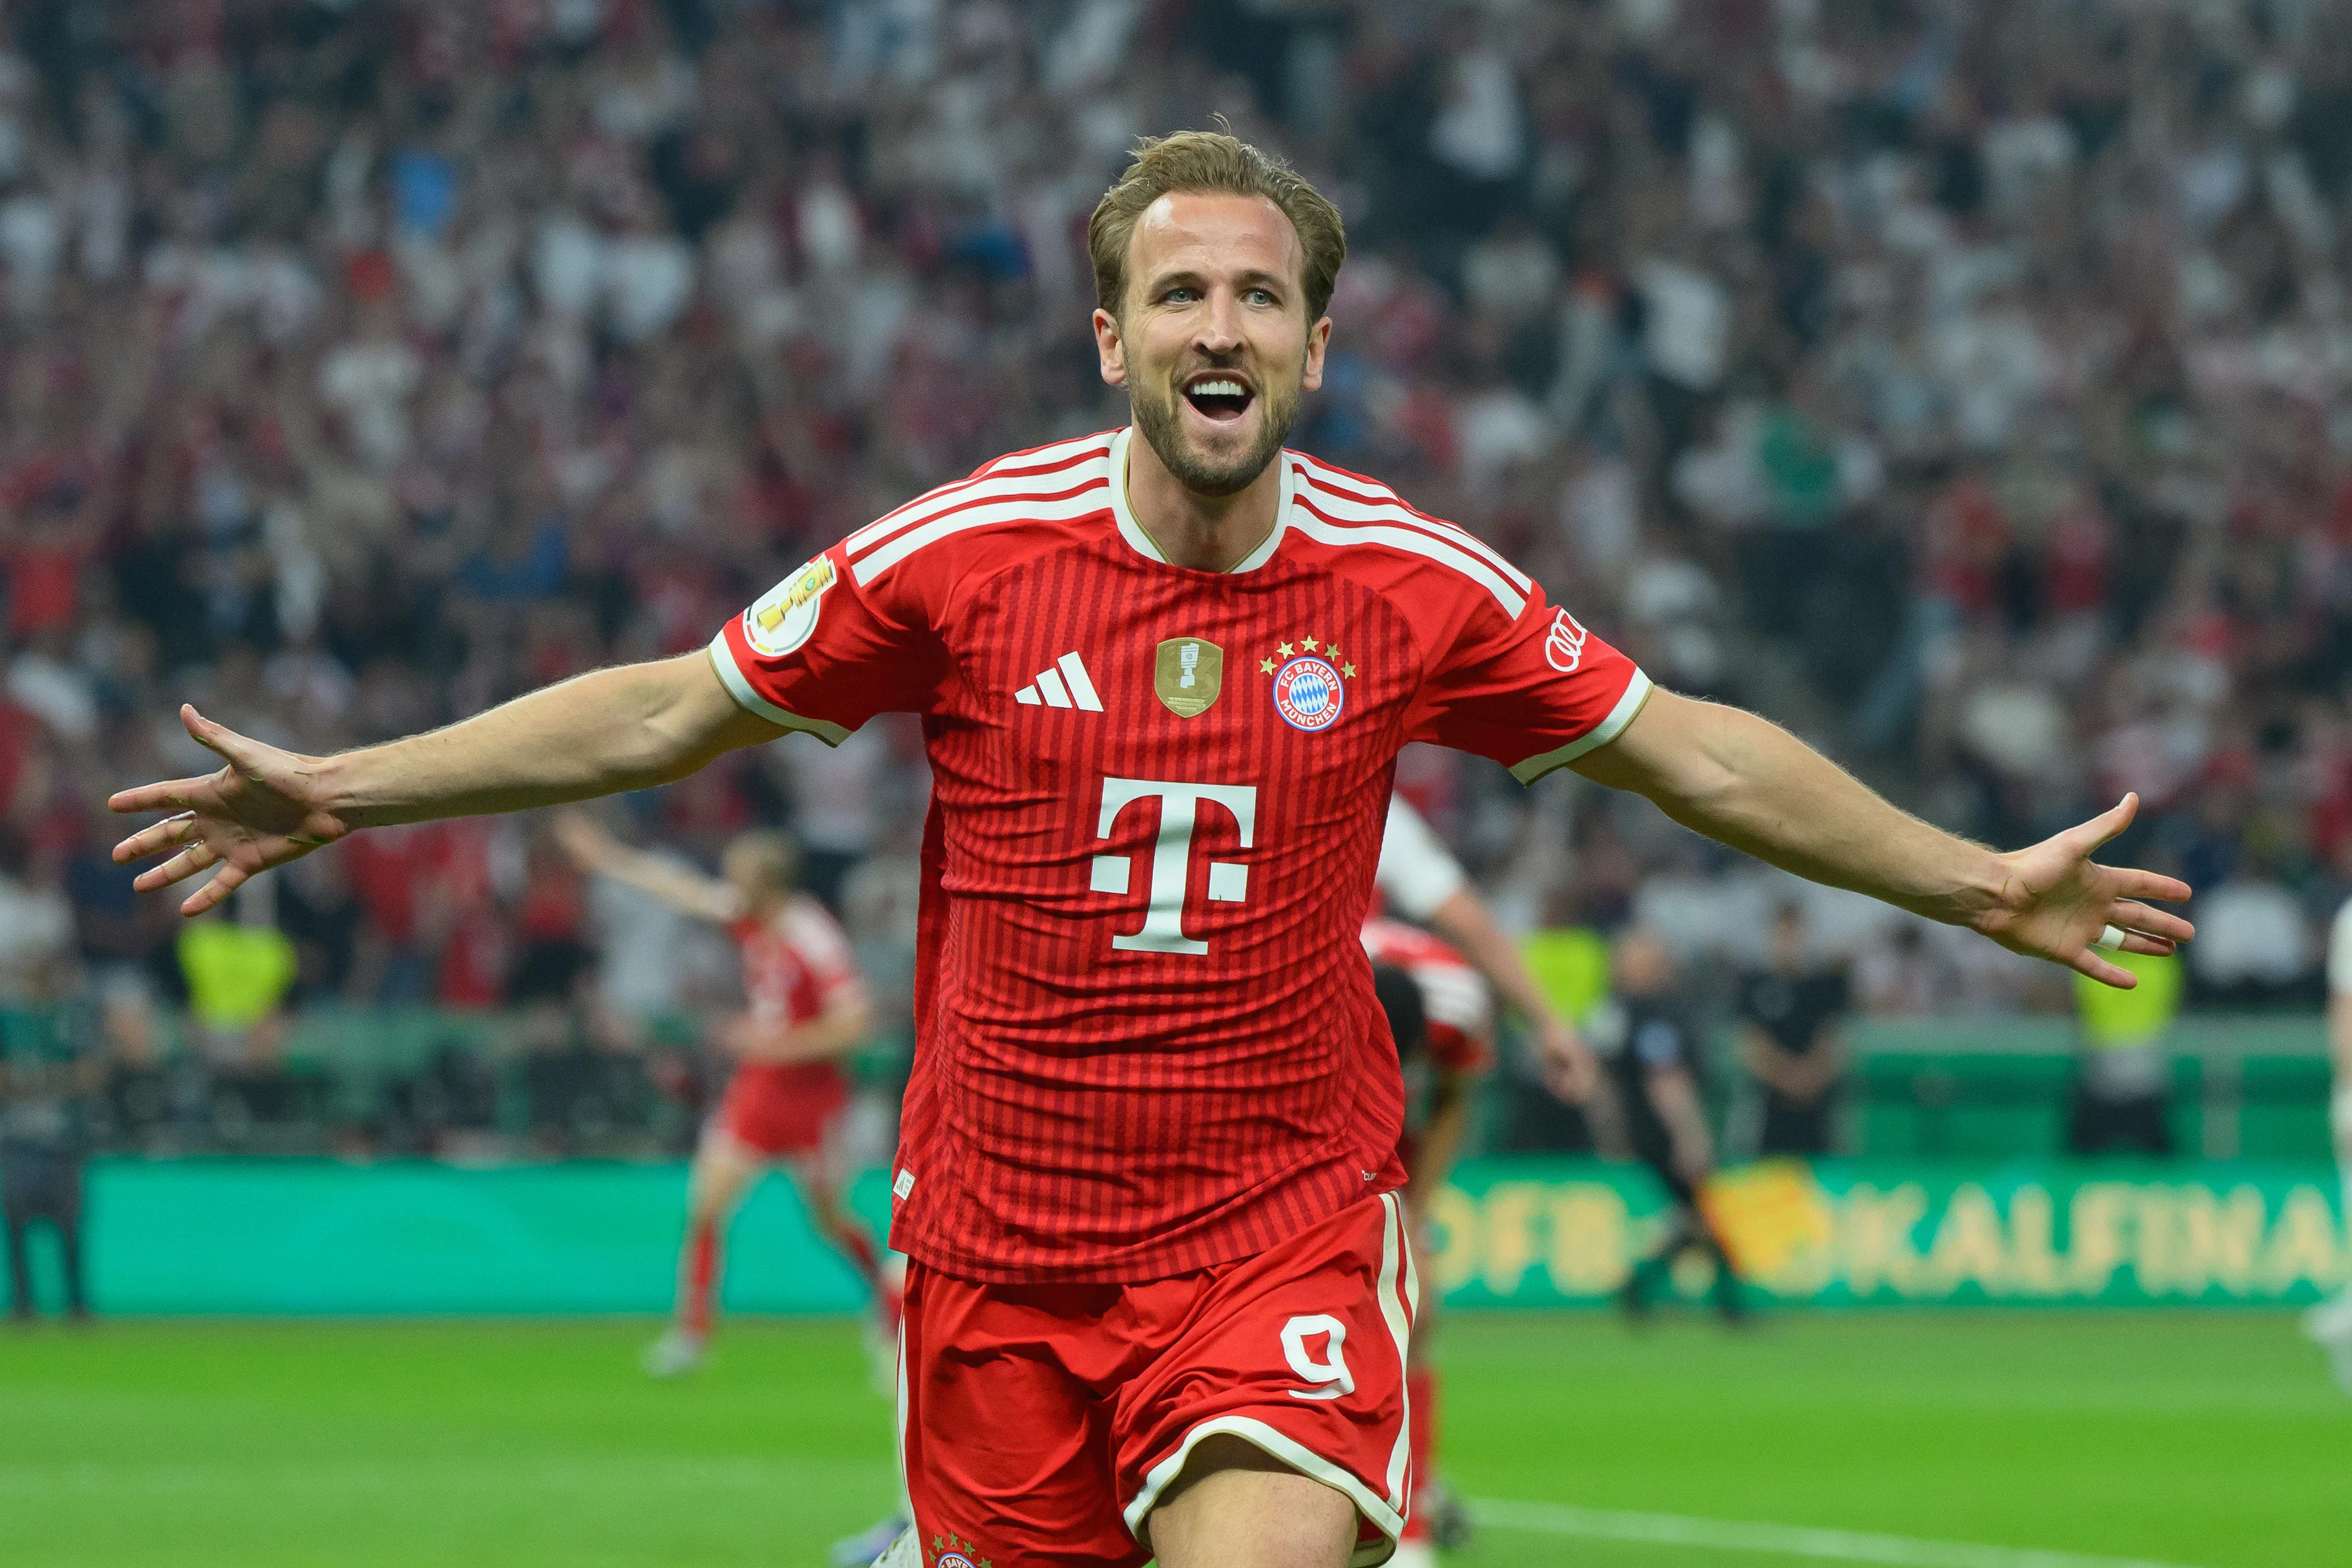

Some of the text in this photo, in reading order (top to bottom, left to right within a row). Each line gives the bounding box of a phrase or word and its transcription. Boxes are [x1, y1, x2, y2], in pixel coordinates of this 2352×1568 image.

[1280, 662, 1338, 691] FC BAYERN
[1280, 699, 1337, 726] MÜNCHEN
[1090, 777, 1257, 955] T
[1279, 1313, 1355, 1400] 9
